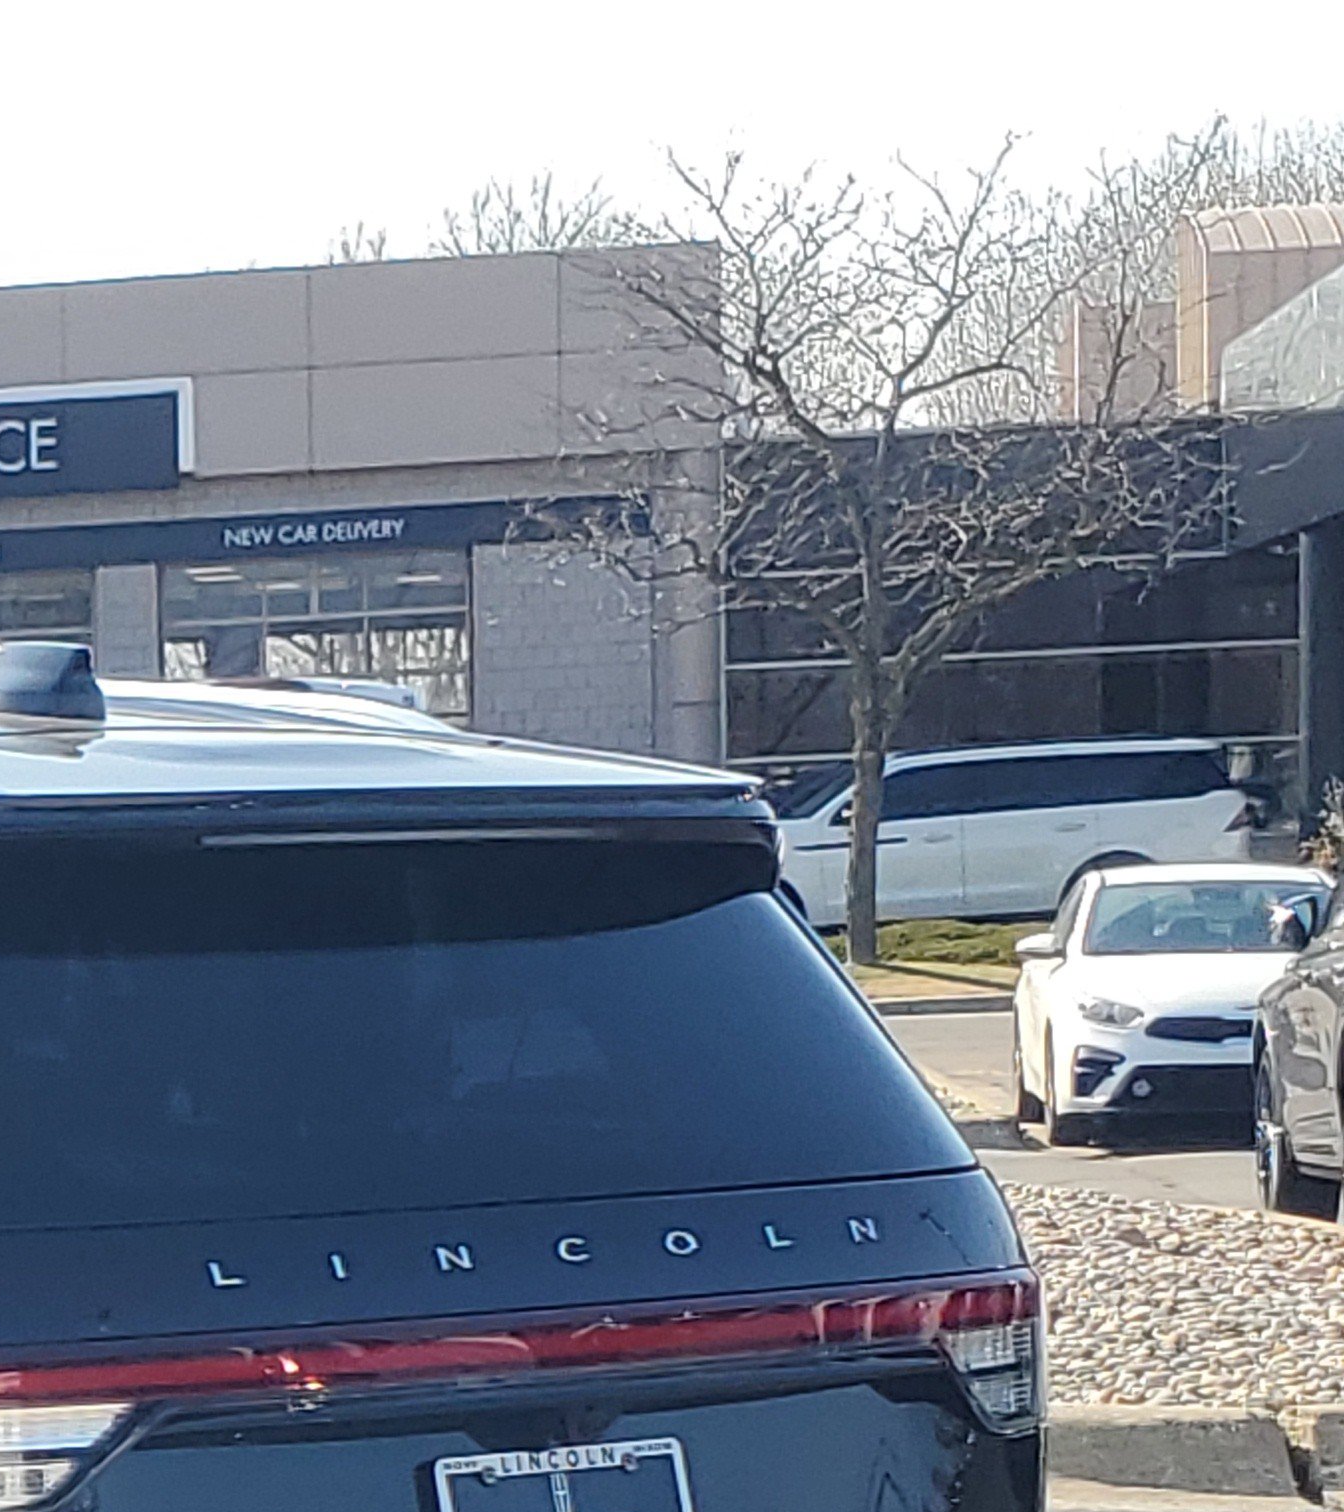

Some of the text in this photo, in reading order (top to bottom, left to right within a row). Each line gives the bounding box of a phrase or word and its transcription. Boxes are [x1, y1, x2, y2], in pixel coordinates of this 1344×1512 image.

[223, 518, 405, 548] NEW CAR DELIVERY
[208, 1215, 879, 1290] LINCOLN
[501, 1446, 616, 1474] LINCOLN
